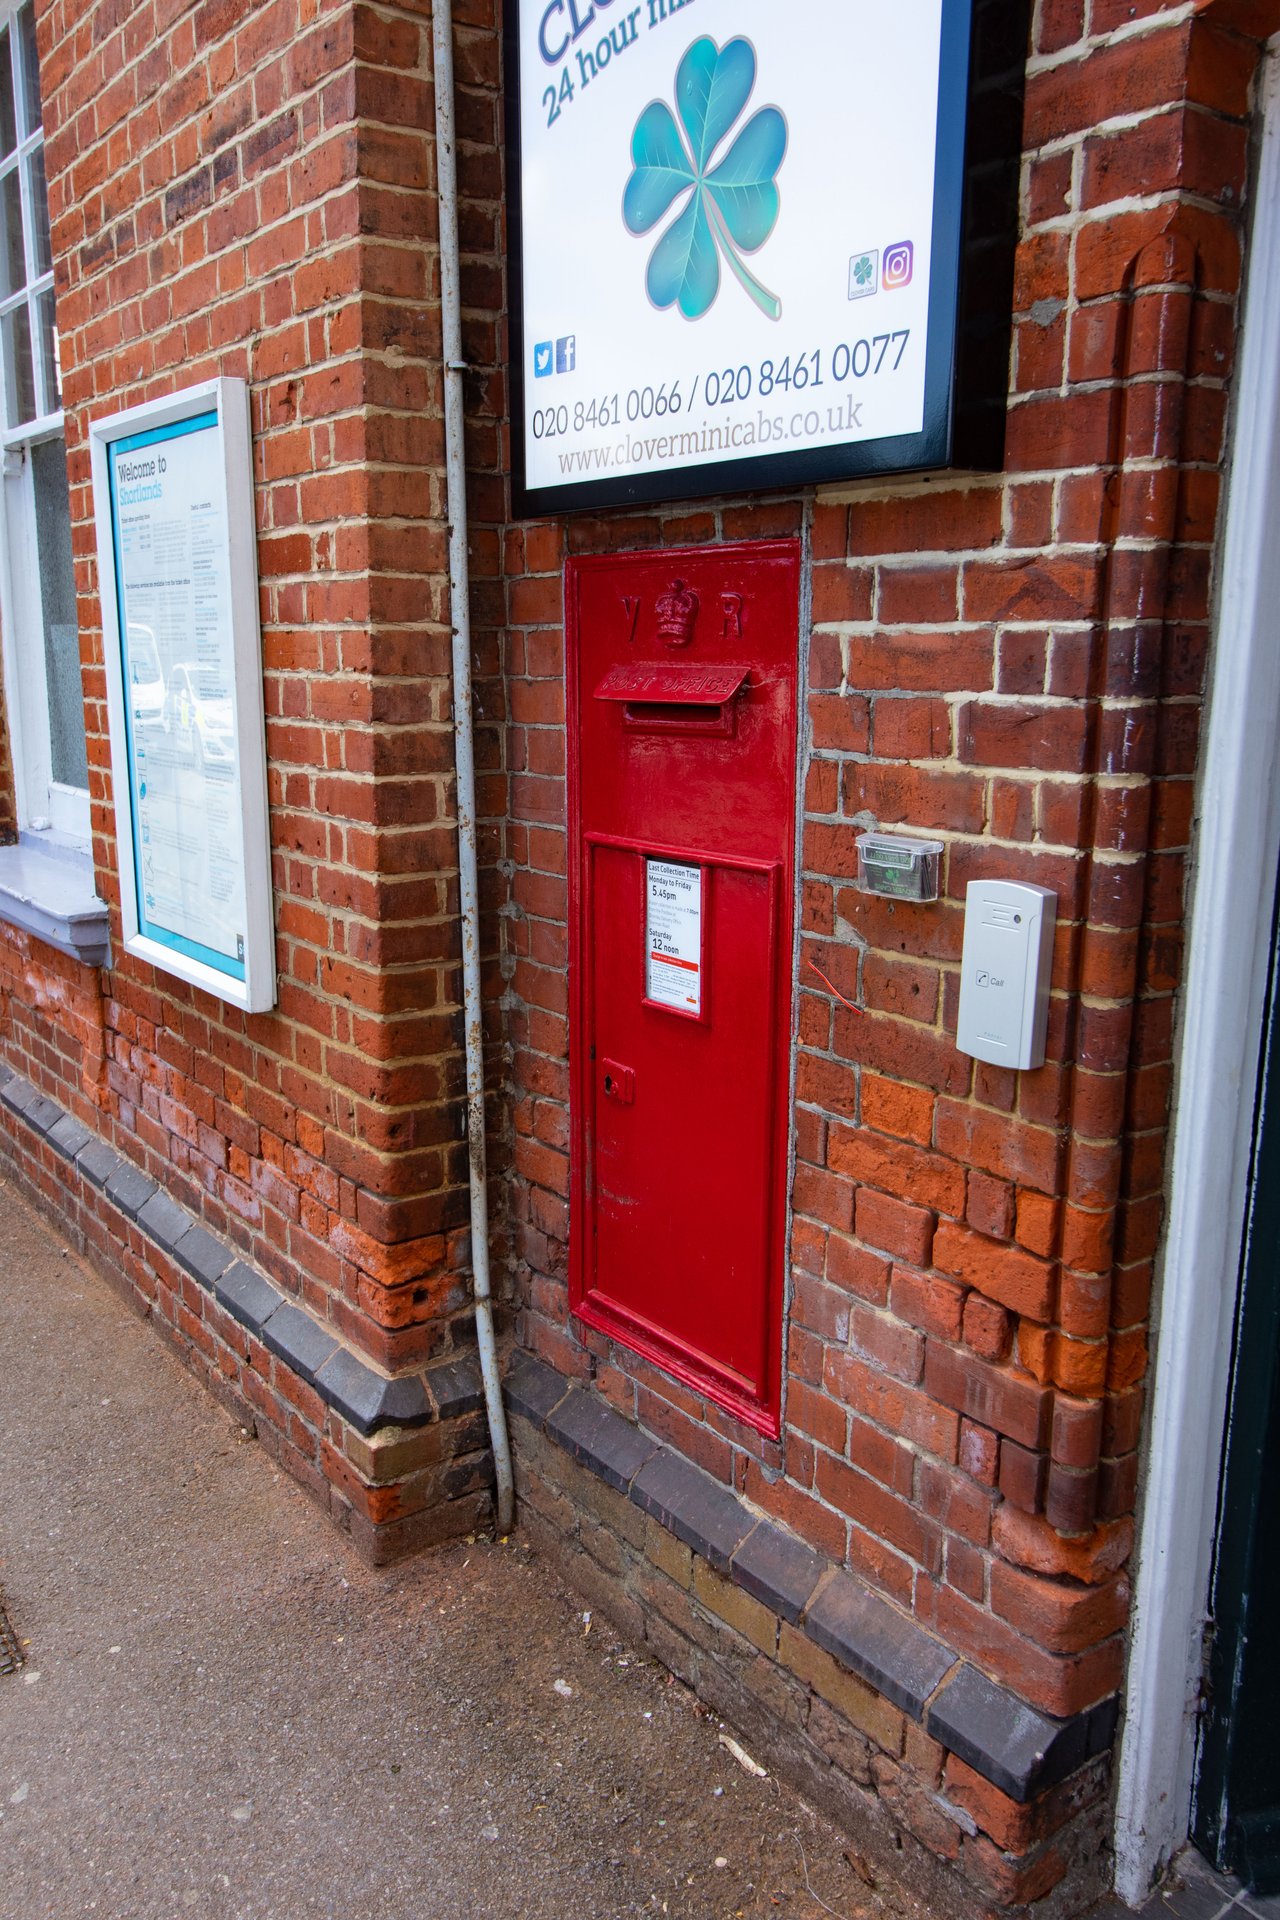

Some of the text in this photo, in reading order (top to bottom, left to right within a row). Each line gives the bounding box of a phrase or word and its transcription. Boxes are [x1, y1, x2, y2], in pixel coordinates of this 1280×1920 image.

[542, 66, 575, 128] 24
[575, 6, 641, 90] hour
[533, 329, 910, 439] 020 8461 0066 / 020 8461 0077
[558, 393, 863, 474] www.cloverminicabs.co.uk
[118, 455, 167, 483] Welcome to
[119, 480, 162, 507] Shortlands
[620, 592, 744, 642] V R
[601, 674, 735, 694] POST OFFICE
[649, 863, 699, 880] Last Collection Time
[649, 875, 668, 887] Monday
[675, 880, 692, 891] Friday
[652, 886, 677, 900] 5.45pm
[649, 928, 672, 941] Saturday
[653, 938, 679, 955] 12 noon
[990, 977, 1005, 987] Call
